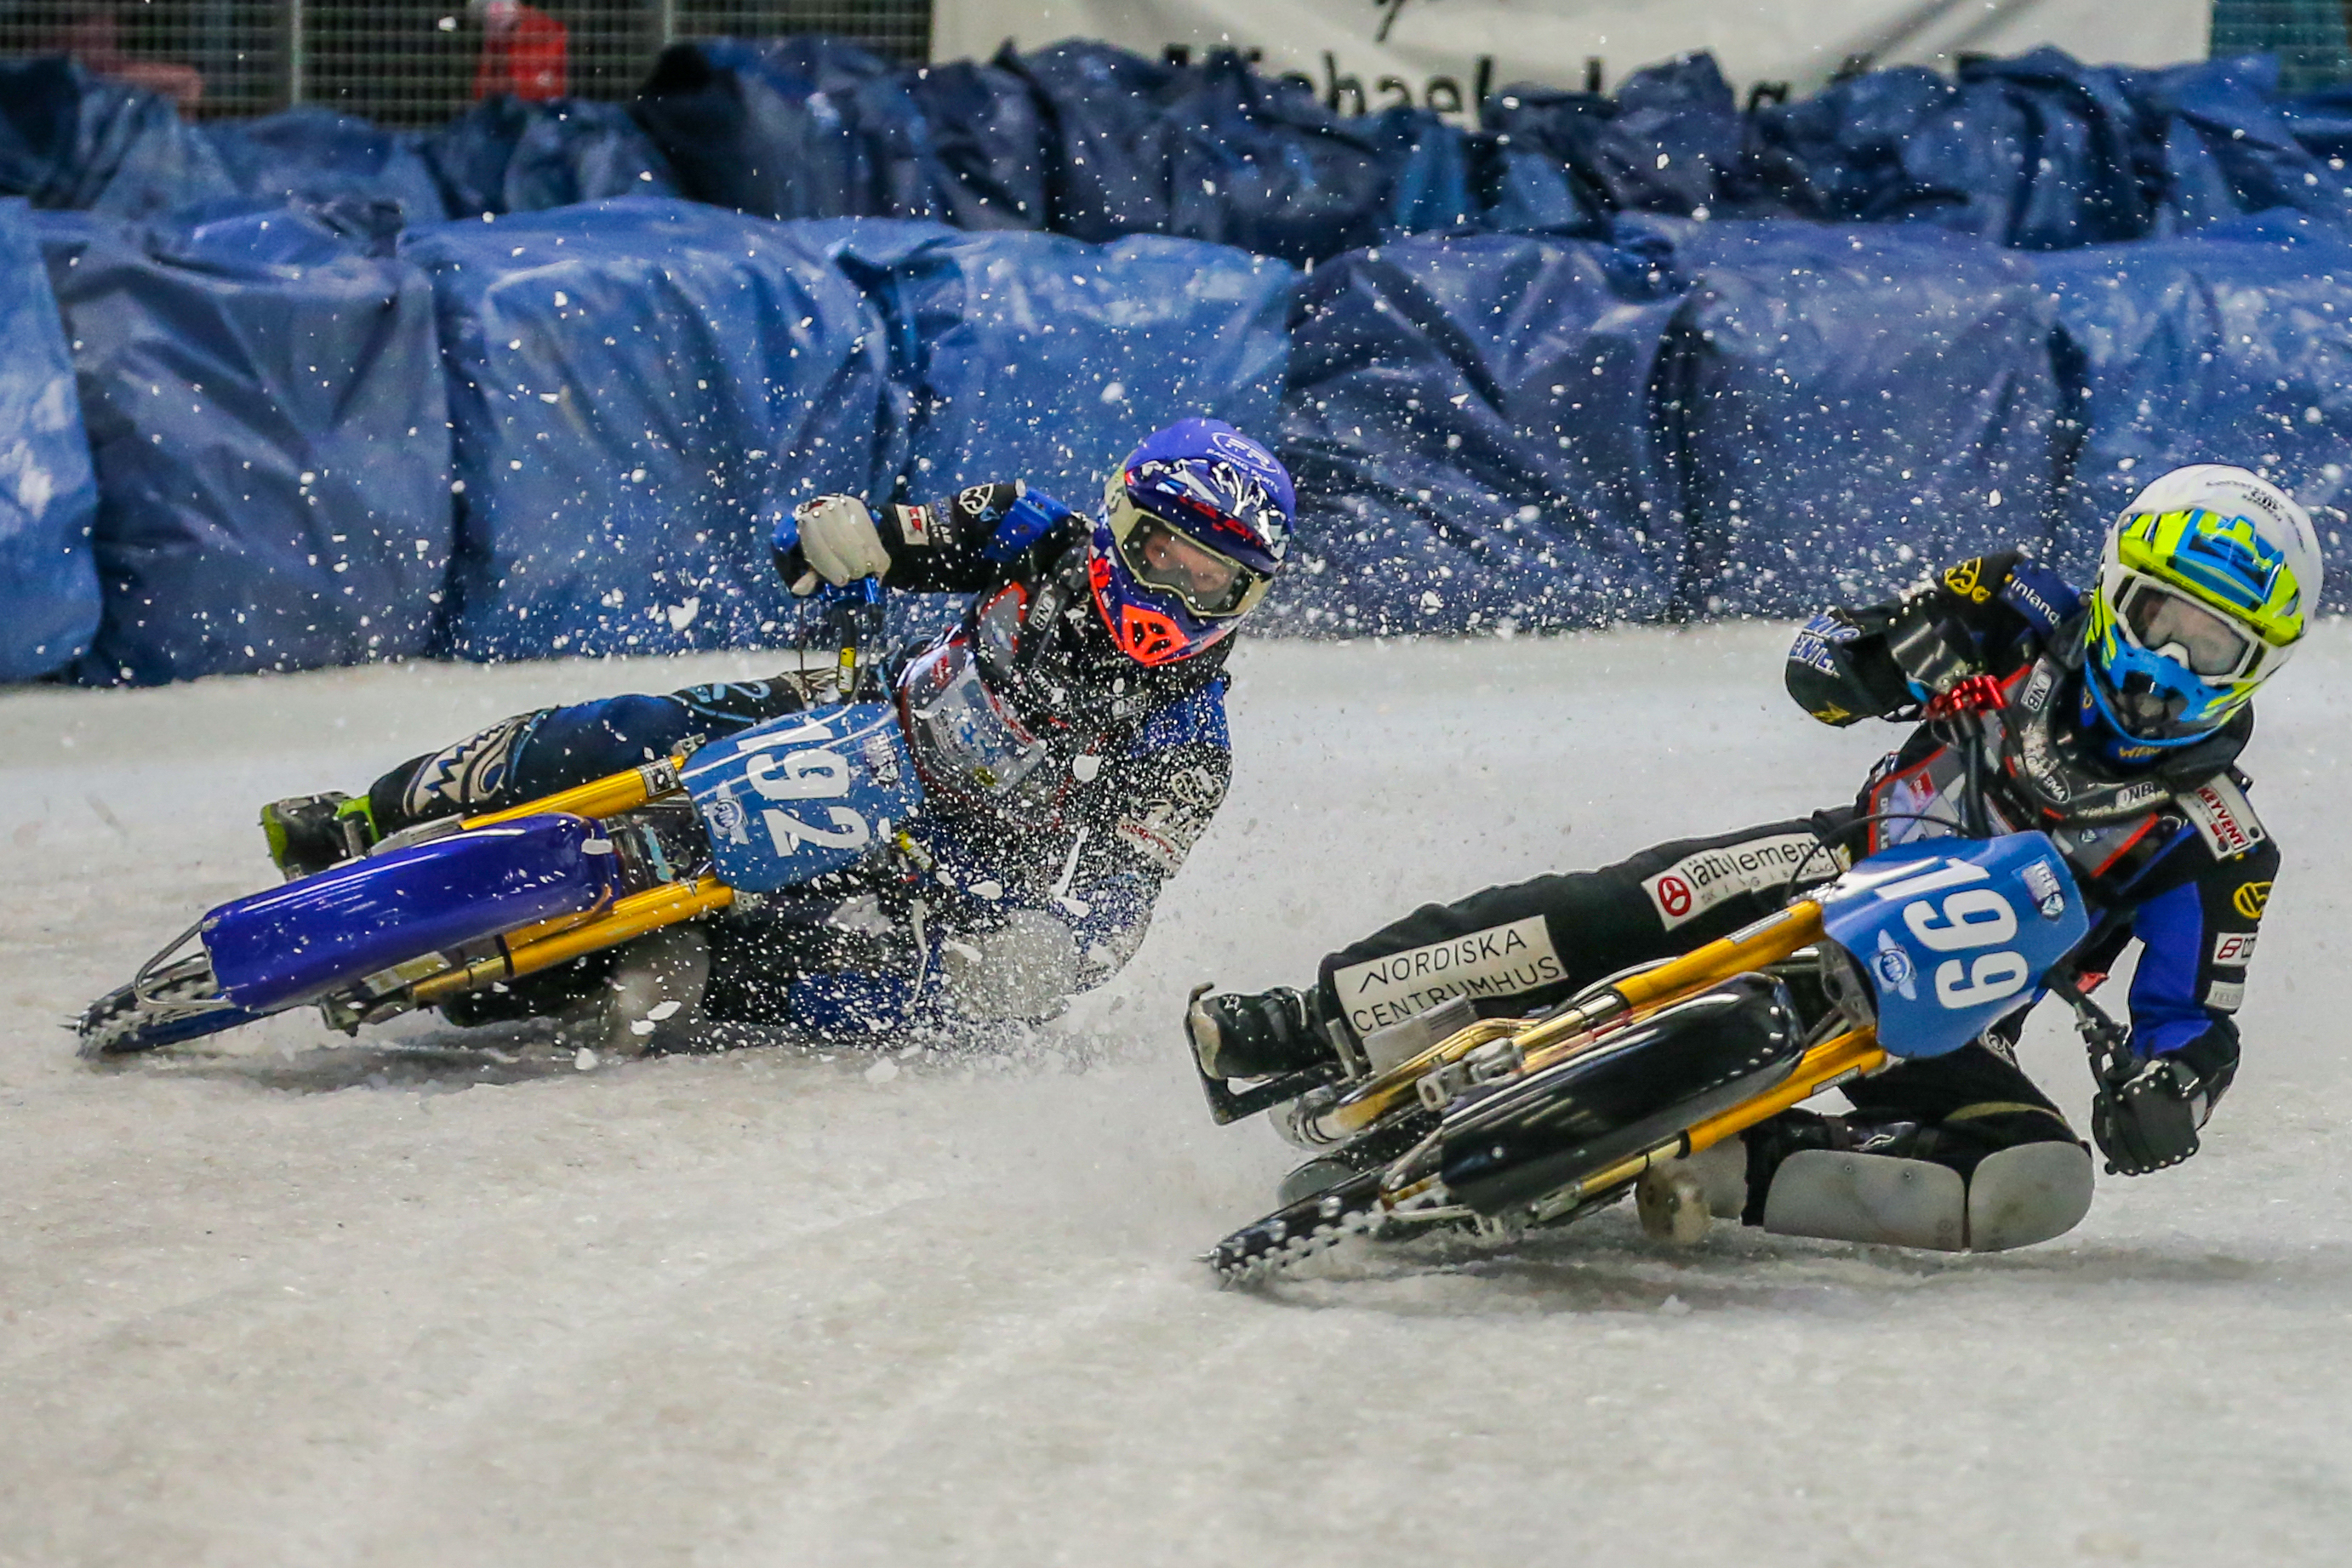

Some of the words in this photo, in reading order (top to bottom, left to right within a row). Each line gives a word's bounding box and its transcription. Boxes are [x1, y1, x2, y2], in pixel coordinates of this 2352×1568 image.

[717, 801, 739, 829] FIM
[2195, 785, 2246, 846] KEYVENT
[1359, 928, 1527, 993] NORDISKA
[1875, 858, 2029, 1010] 199
[1351, 955, 1561, 1032] CENTRUMHUS
